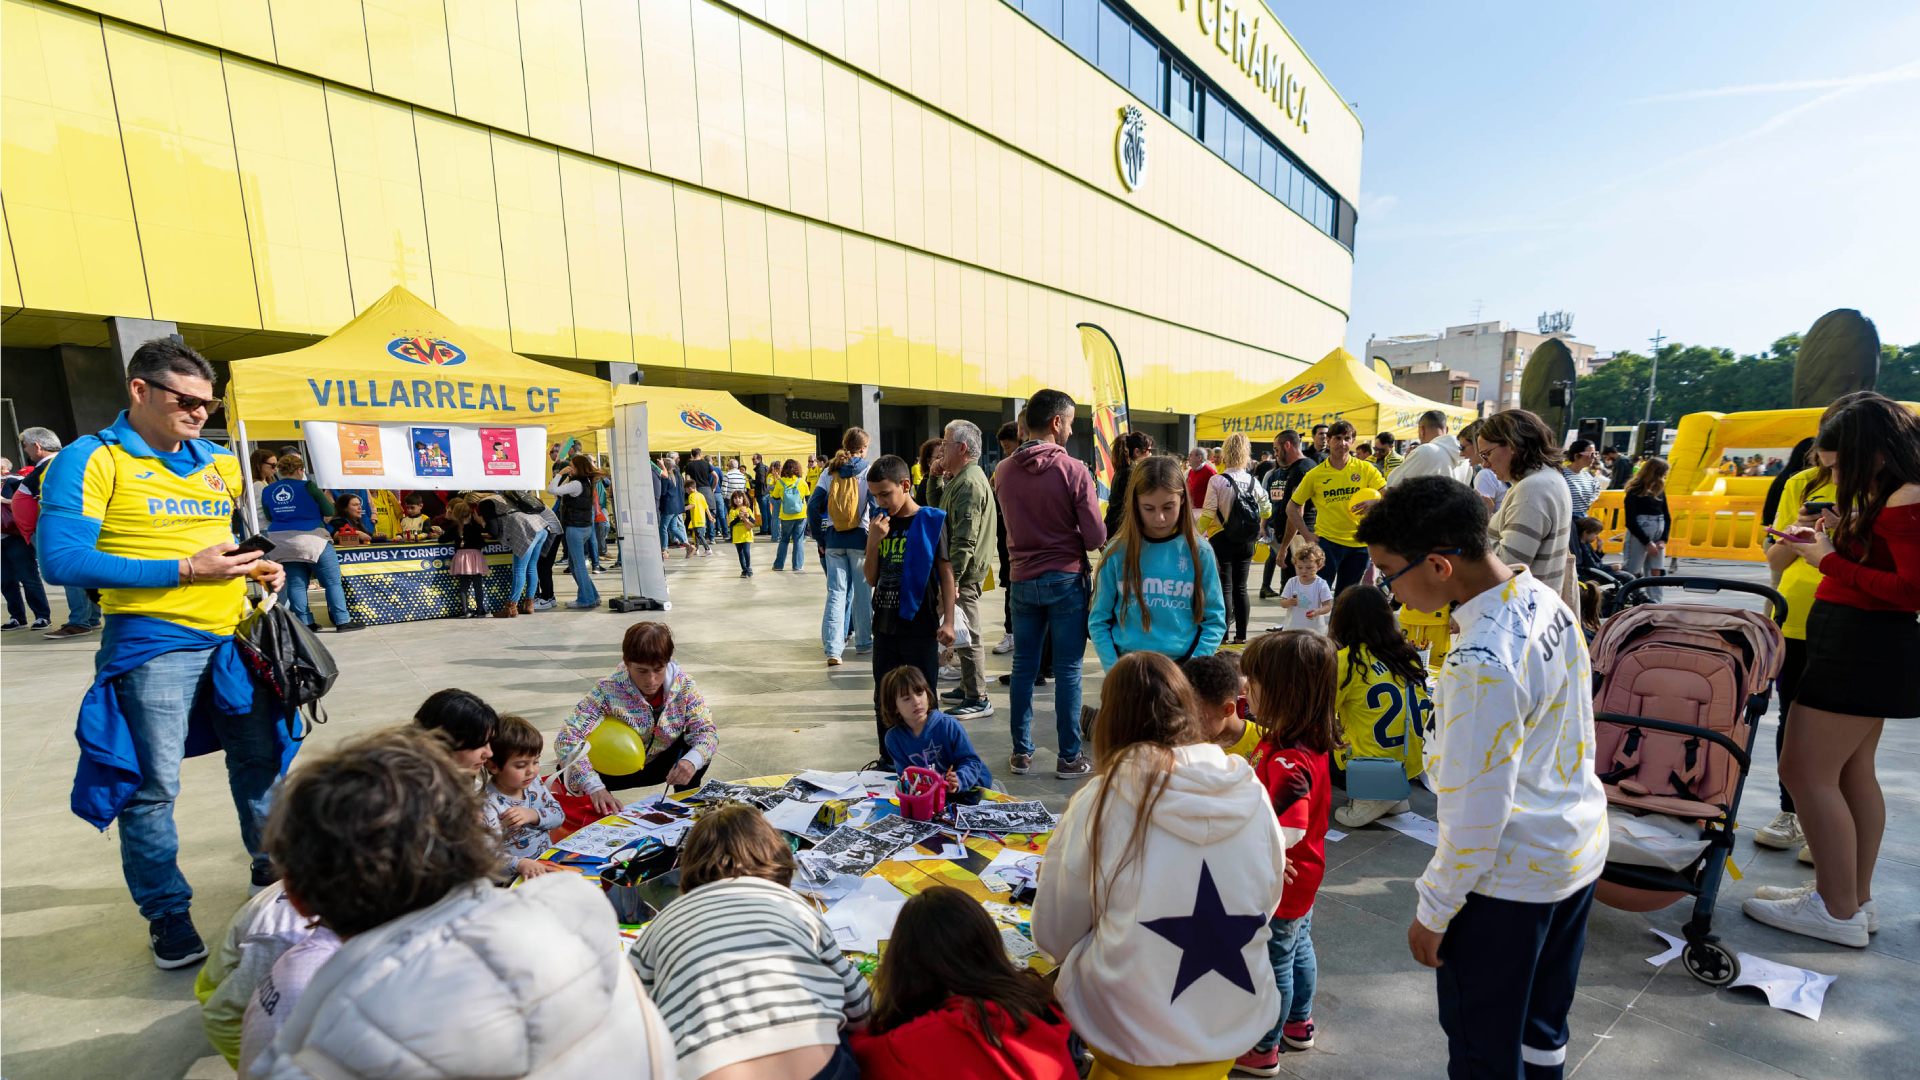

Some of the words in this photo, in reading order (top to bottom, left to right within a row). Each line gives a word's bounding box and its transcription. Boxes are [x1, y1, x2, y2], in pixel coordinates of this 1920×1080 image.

[1197, 0, 1309, 134] CERÁMICA
[307, 378, 516, 412] VILLARREAL
[526, 386, 561, 413] CF
[792, 410, 799, 419] EL
[801, 411, 835, 421] CERAMISTA
[1222, 412, 1315, 433] VILLARREAL
[1323, 486, 1361, 498] PAMESA
[147, 498, 231, 516] PAMESA
[336, 551, 389, 563] CAMPUS
[389, 550, 399, 559] Y
[400, 546, 456, 559] TORNEOS
